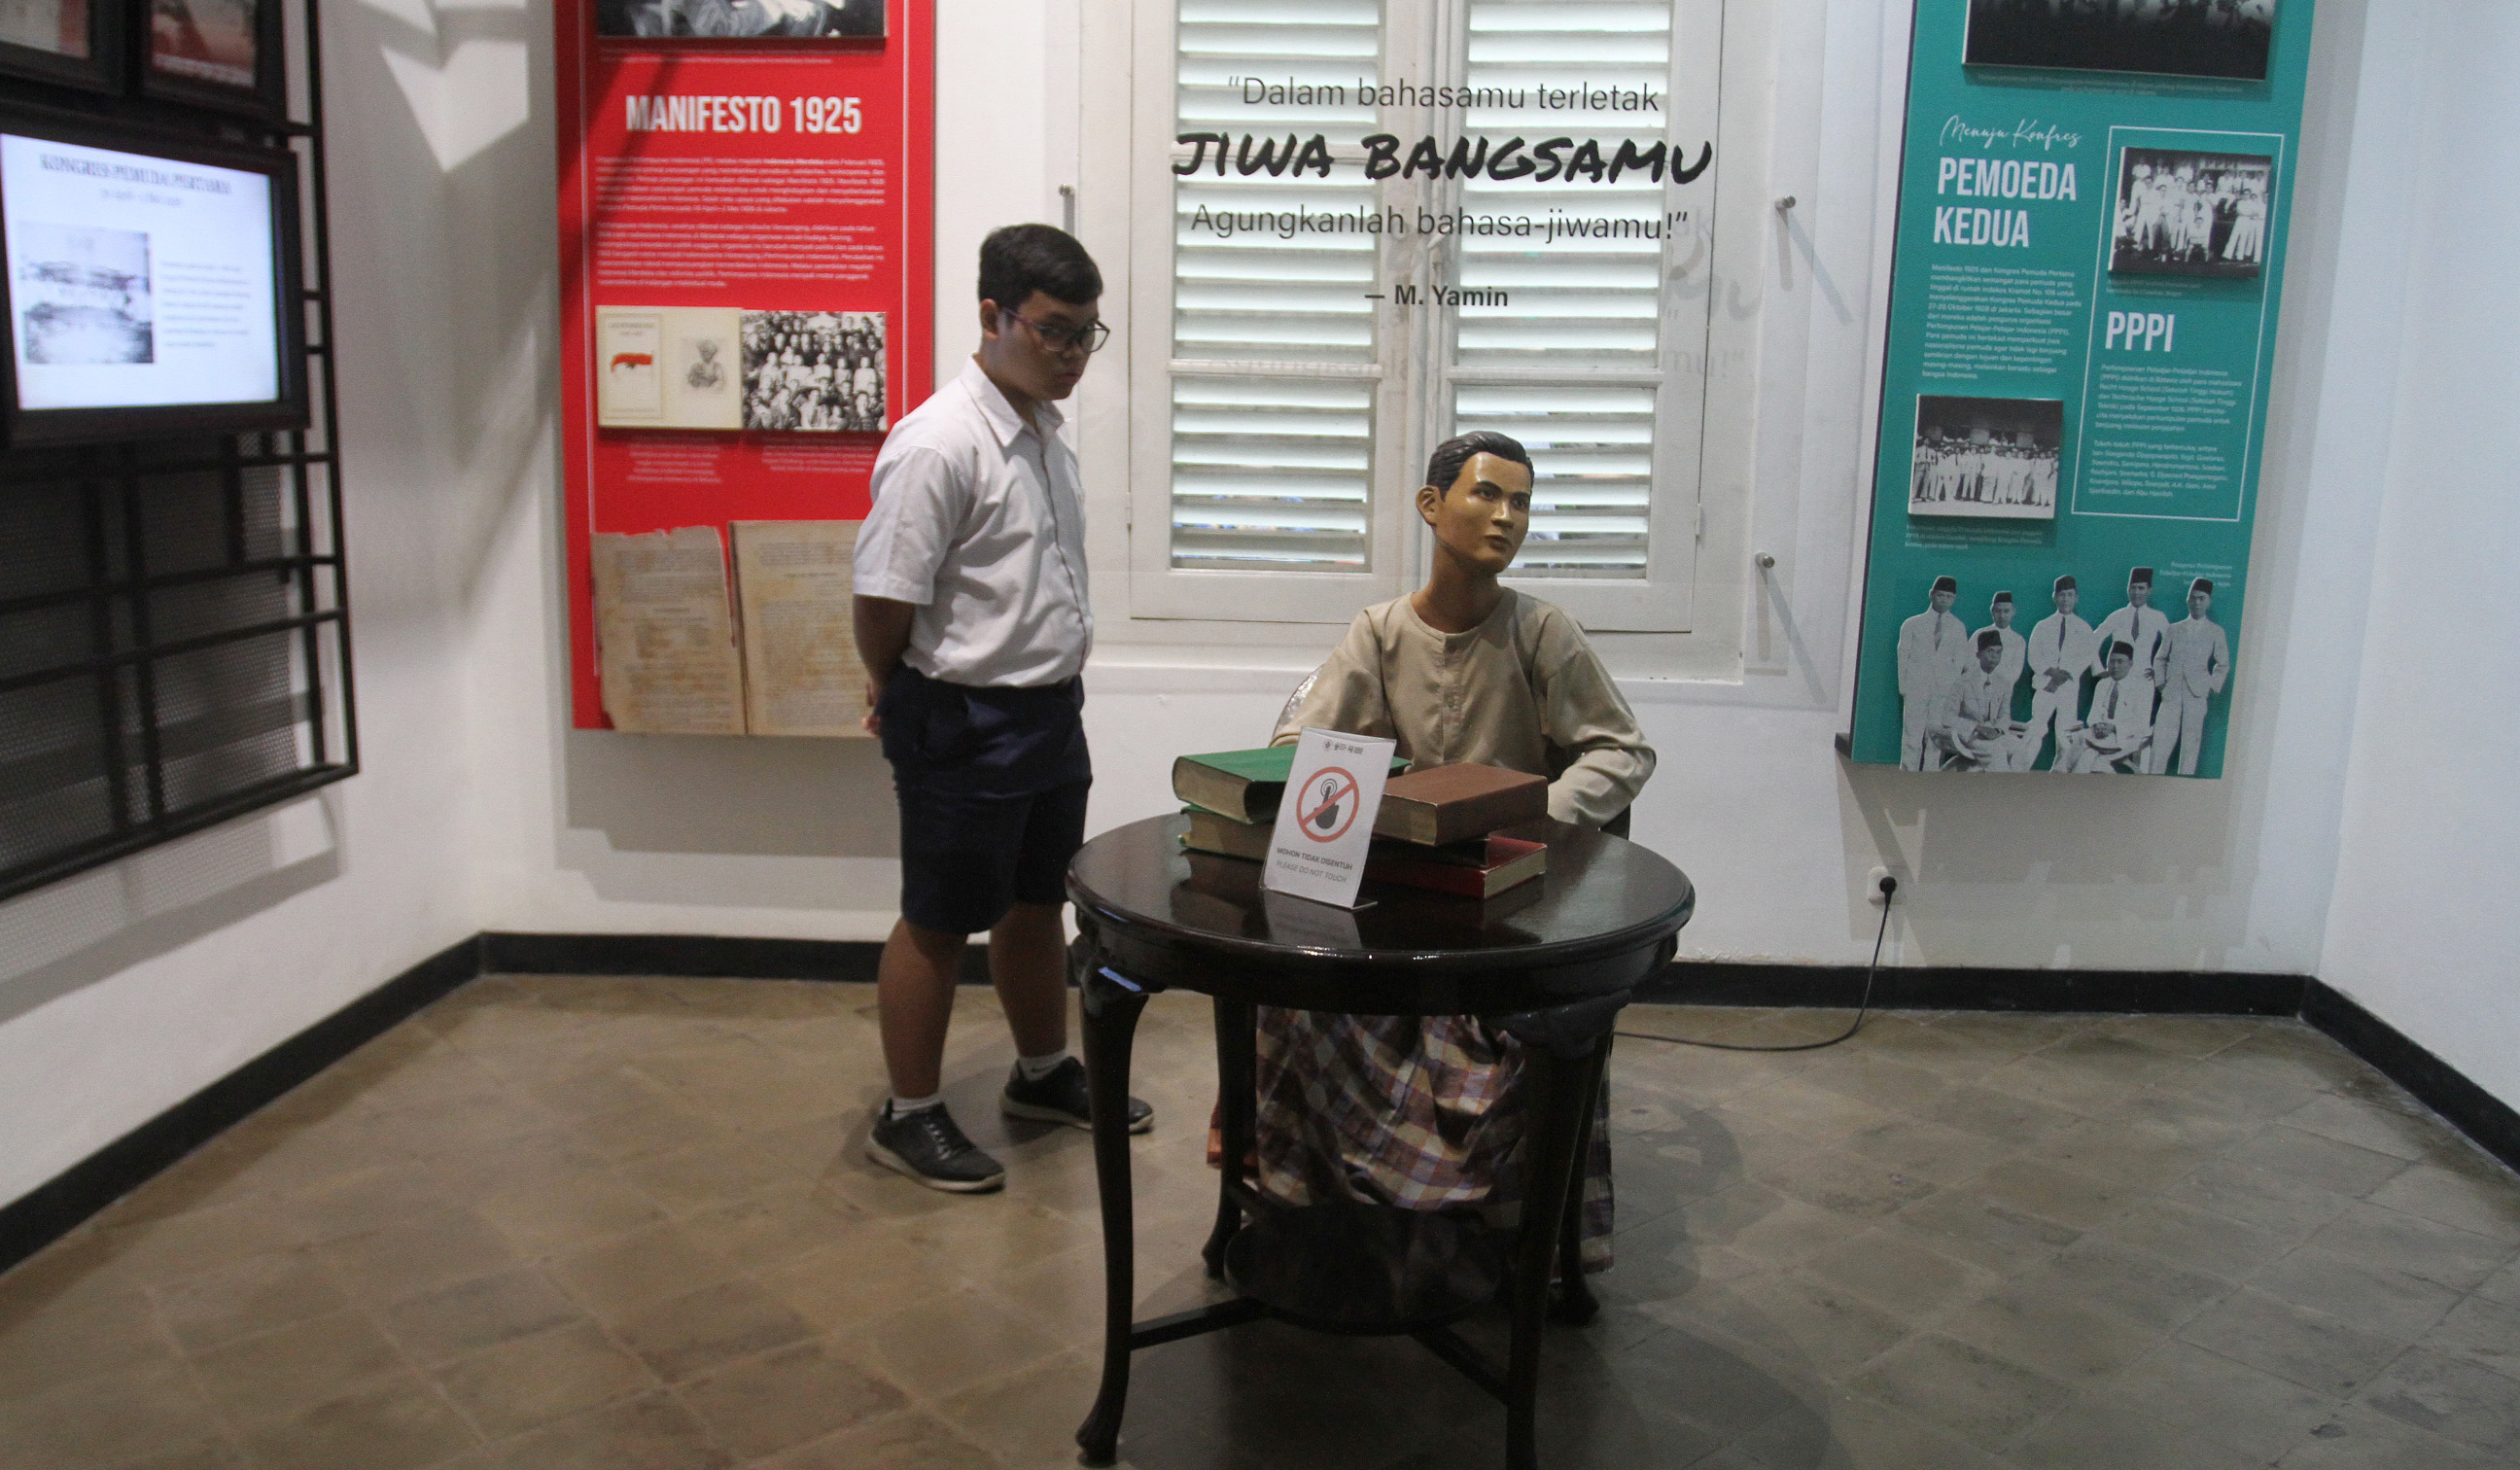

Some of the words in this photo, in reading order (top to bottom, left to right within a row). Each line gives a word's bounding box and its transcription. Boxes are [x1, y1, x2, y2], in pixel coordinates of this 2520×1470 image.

[1229, 76, 1345, 106] “Dalam
[1358, 78, 1523, 108] bahasamu
[1538, 82, 1659, 111] terletak
[625, 95, 782, 132] MANIFESTO
[789, 96, 862, 133] 1925
[1940, 115, 2009, 149] Menuju
[1172, 131, 1335, 178] JIWA
[1361, 133, 1712, 184] BANGSAMU
[1938, 157, 2077, 200] PEMOEDA
[1191, 203, 1404, 239] Agungkanlah
[1418, 205, 1688, 244] bahasa-jiwamu!”
[1934, 206, 2029, 247] KEDUA
[1395, 285, 1423, 305] M.
[1432, 285, 1508, 306] Yamin
[2105, 311, 2176, 352] PPPI
[1277, 847, 1300, 858] MOHON
[1302, 853, 1319, 862] TIDAK
[1320, 857, 1353, 870] DISENTUH
[1277, 860, 1298, 871] PLEASE
[1310, 868, 1323, 877] NOT
[1325, 872, 1348, 883] TOUCH
